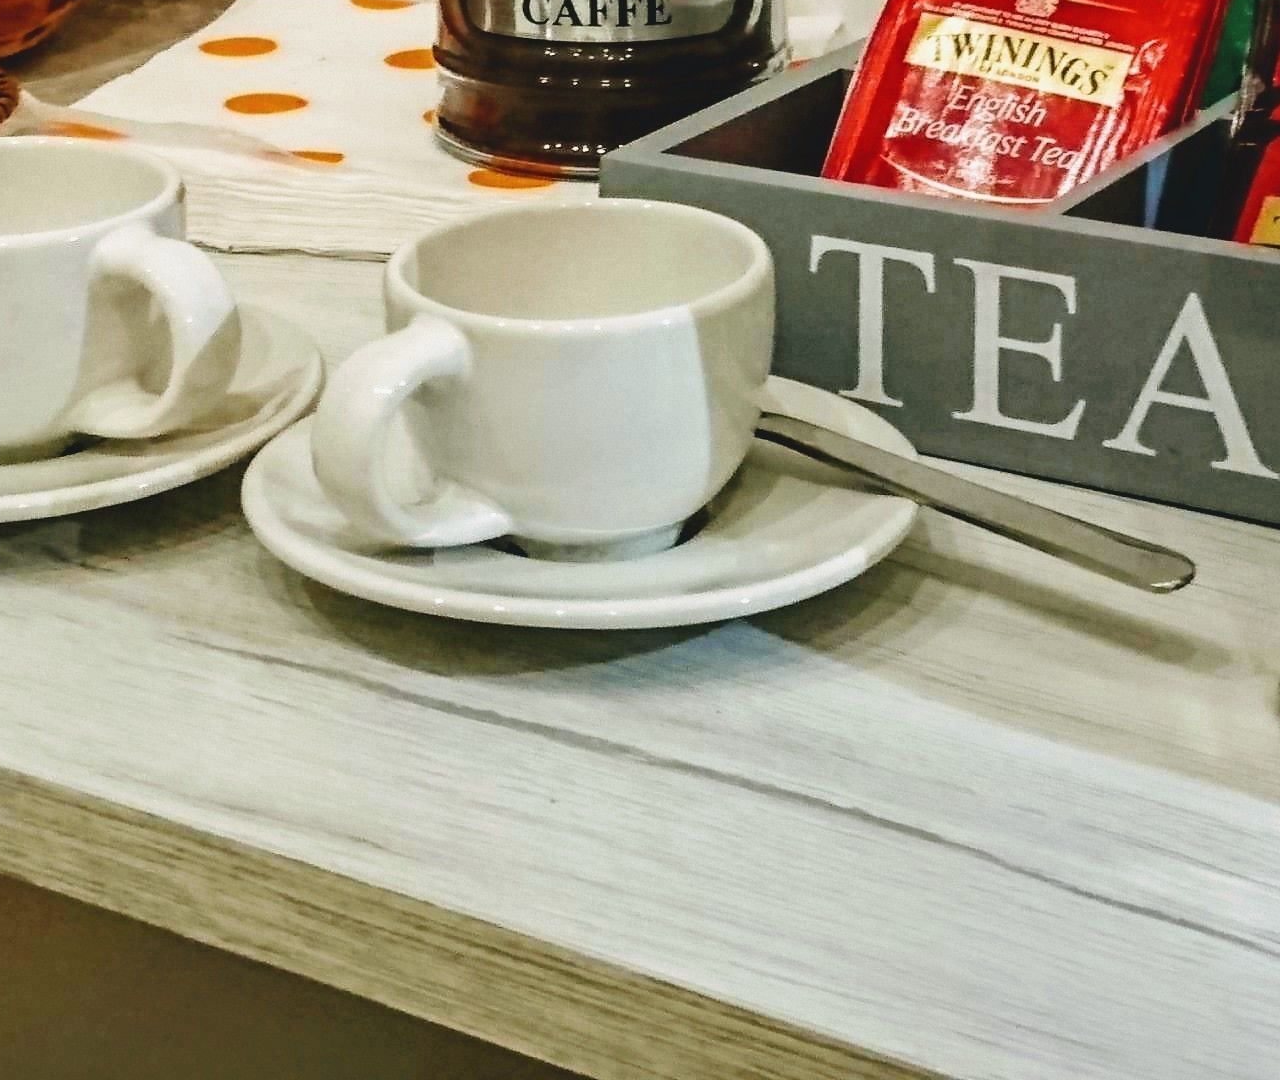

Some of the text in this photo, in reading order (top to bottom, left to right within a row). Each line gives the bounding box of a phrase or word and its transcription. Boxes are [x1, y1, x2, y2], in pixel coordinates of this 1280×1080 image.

[927, 31, 1110, 97] TWININGS
[946, 83, 1048, 128] English
[896, 106, 1081, 171] Breakfast Tea
[809, 234, 1280, 481] TEA
